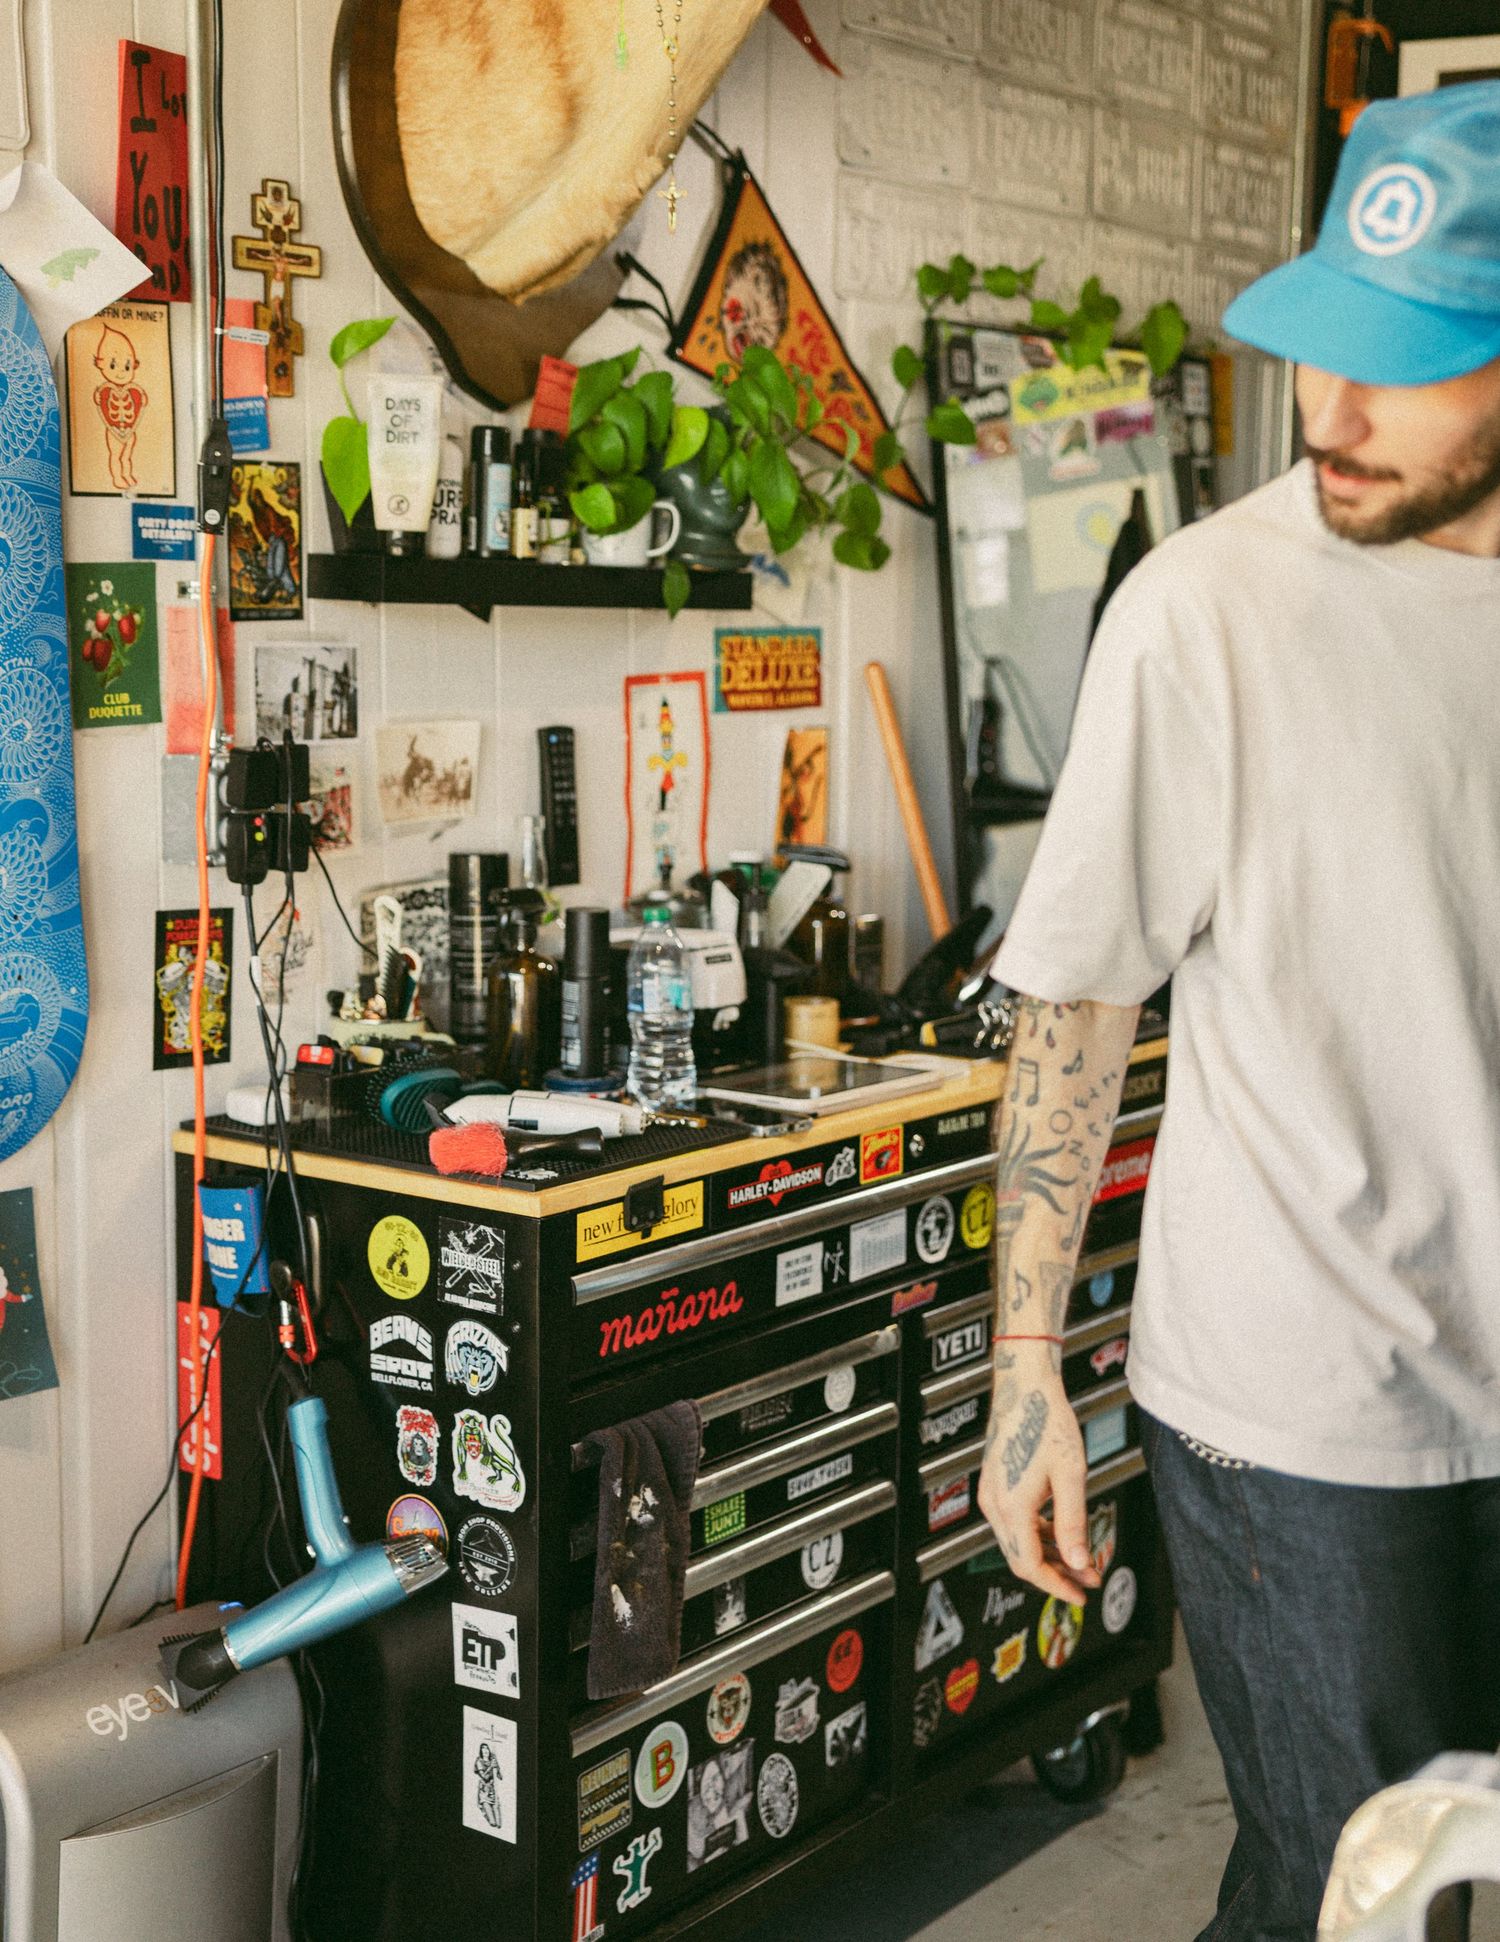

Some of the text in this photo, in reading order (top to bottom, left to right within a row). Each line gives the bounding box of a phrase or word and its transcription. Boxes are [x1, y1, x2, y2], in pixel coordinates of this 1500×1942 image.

[130, 51, 157, 133] I
[121, 307, 134, 319] OR
[136, 308, 164, 322] MINE?
[385, 398, 421, 412] DAYS
[390, 414, 413, 428] OF
[386, 430, 418, 444] DIRT
[89, 704, 143, 719] DUQUETTE
[103, 693, 130, 705] CLUB
[584, 1219, 613, 1242] new
[662, 1194, 699, 1224] glory
[600, 1279, 743, 1357] mañana
[369, 1314, 433, 1362] BEANS
[938, 1322, 982, 1362] YETI
[808, 1534, 836, 1573] CZ
[650, 1739, 675, 1793] B
